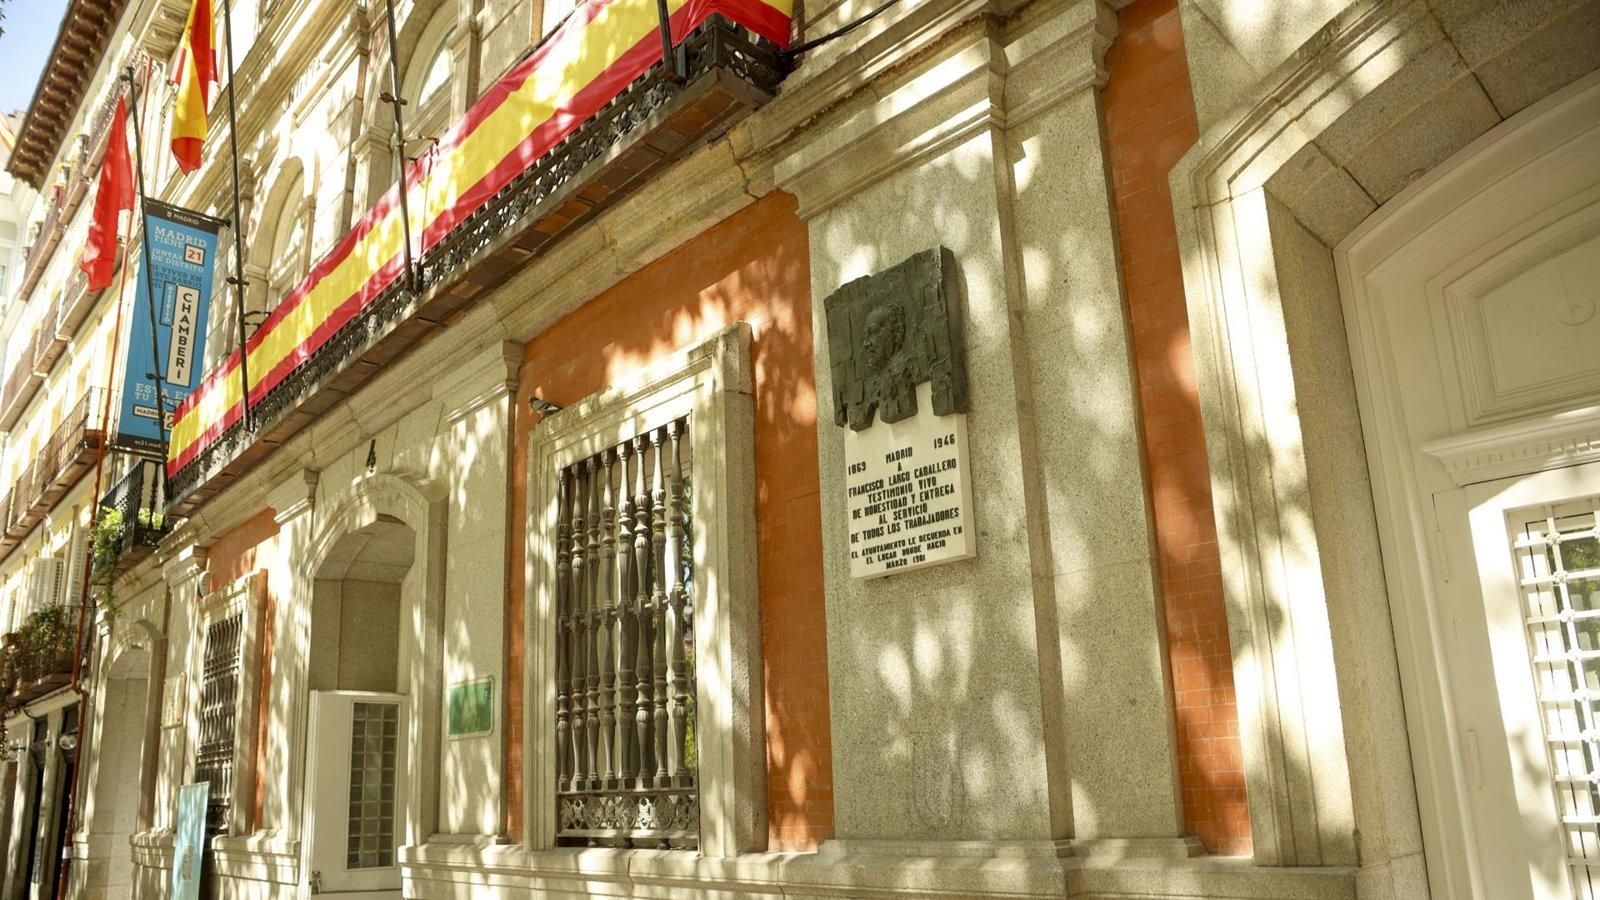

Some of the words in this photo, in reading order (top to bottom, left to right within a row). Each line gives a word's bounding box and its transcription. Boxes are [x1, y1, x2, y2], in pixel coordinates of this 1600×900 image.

[154, 226, 207, 248] MADRID
[188, 249, 202, 261] 21
[848, 461, 866, 476] 1869
[885, 446, 912, 464] MADRID
[933, 433, 955, 449] 1946
[897, 461, 903, 472] A
[849, 479, 884, 498] FRANCISCO
[888, 471, 910, 486] LARGO
[914, 458, 956, 479] CABALLERO
[867, 482, 913, 504] TESTIMONIO
[918, 476, 937, 490] VIVO
[853, 508, 862, 520] DE
[864, 496, 907, 517] HONESTIDAD
[911, 493, 916, 504] Y
[919, 483, 955, 502] ENTREGA
[879, 513, 888, 525] AL
[893, 502, 928, 521] SERVICIO
[851, 532, 859, 544] DE
[862, 526, 884, 541] TODOS
[887, 522, 901, 535] LOS
[904, 507, 960, 530] TRABAJADORES
[851, 551, 859, 559] EL
[861, 539, 906, 557] AYUNTAMIENTO
[908, 537, 916, 546] LE
[918, 528, 951, 543] RECUERDA
[953, 525, 963, 535] EN
[866, 556, 874, 565] EL
[877, 551, 897, 562] LUGAR
[902, 545, 921, 556] DONDE
[926, 539, 946, 550] NACIO
[886, 558, 908, 569] MARZO
